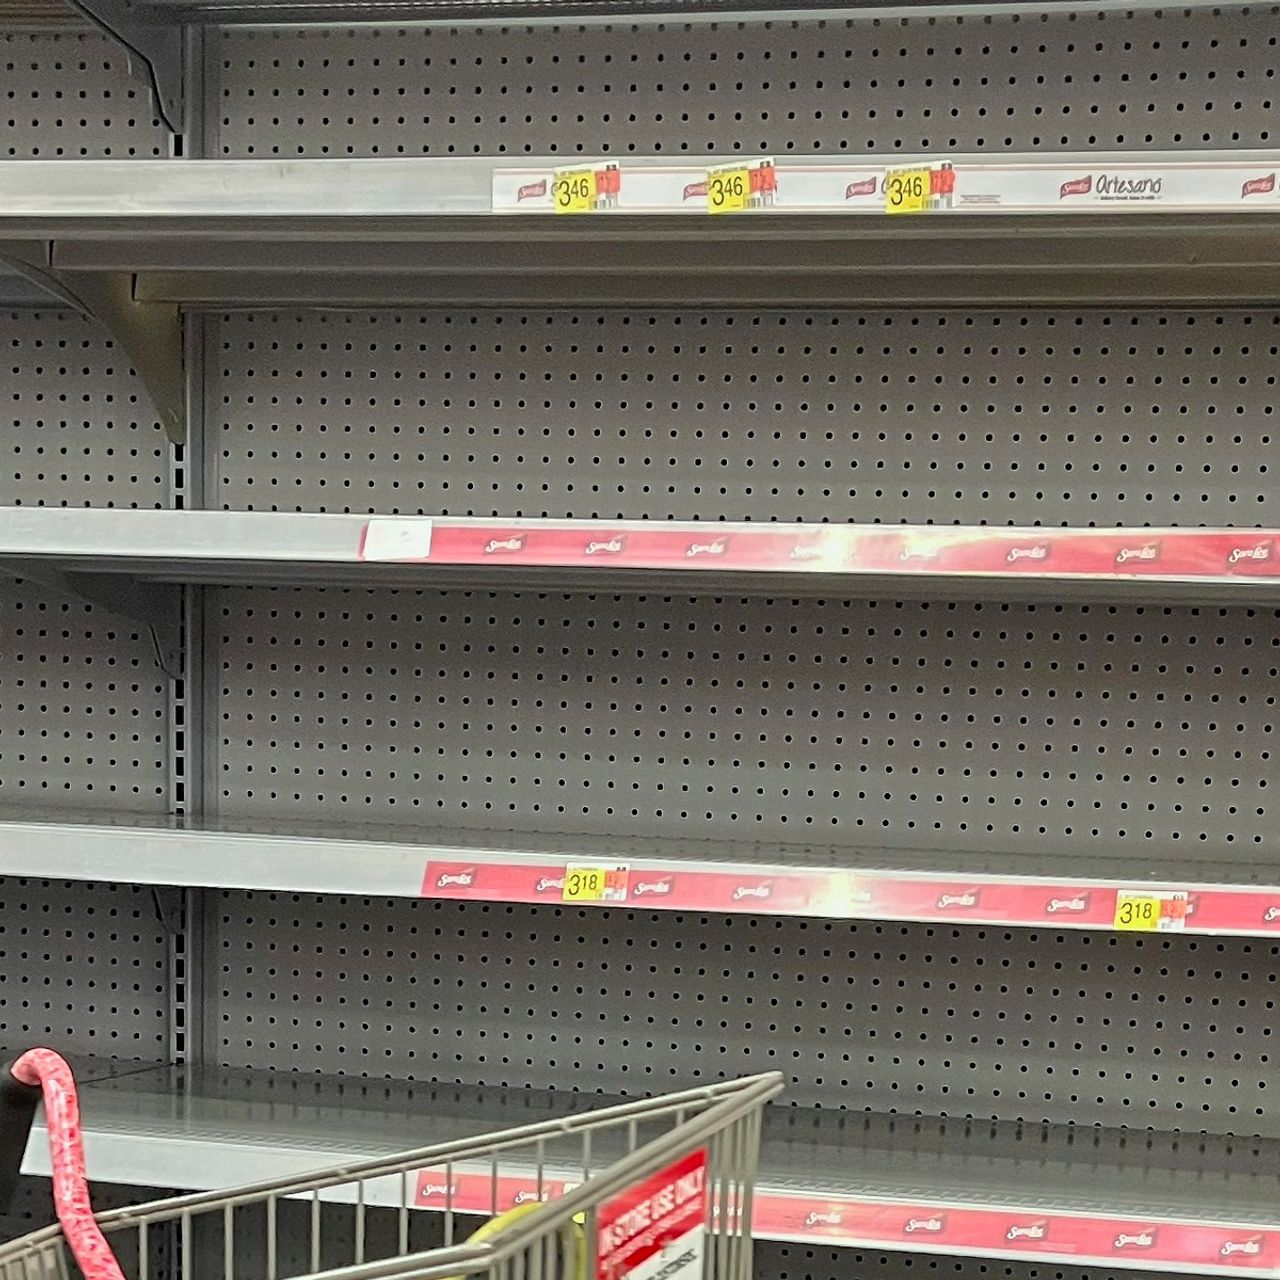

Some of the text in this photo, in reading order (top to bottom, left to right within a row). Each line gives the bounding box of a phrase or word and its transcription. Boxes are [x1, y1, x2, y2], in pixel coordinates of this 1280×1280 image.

[558, 178, 589, 207] 346
[711, 176, 743, 206] 346
[890, 176, 922, 206] 346
[568, 874, 598, 896] 318
[1120, 902, 1152, 924] 318
